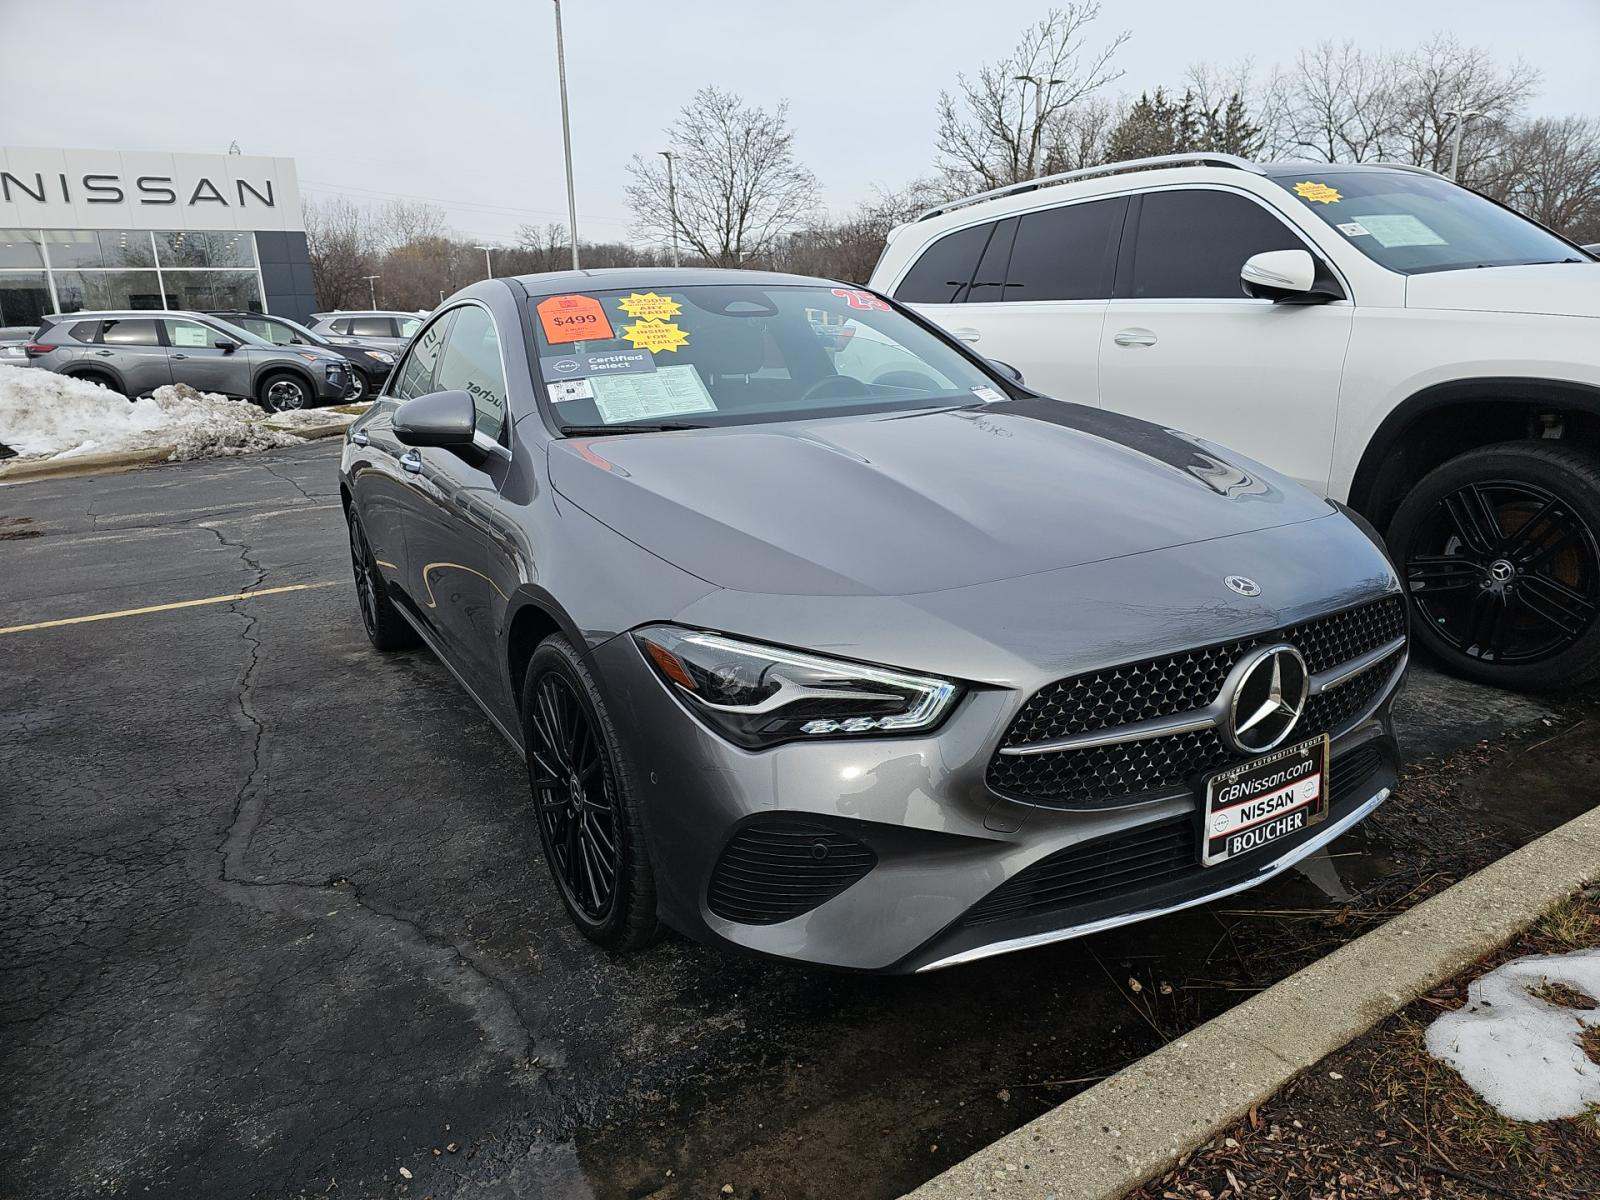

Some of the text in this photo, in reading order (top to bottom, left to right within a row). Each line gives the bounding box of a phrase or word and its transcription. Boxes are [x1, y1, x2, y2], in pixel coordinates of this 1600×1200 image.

[0, 172, 275, 207] NISSAN
[553, 314, 597, 327] $499
[588, 354, 643, 364] Certified
[590, 361, 631, 371] Select
[1253, 746, 1298, 767] AUTOMOTIVE
[1219, 760, 1313, 803] GBNissan.com
[1240, 790, 1294, 823] NISSAN
[1233, 812, 1303, 854] BOUCHER
